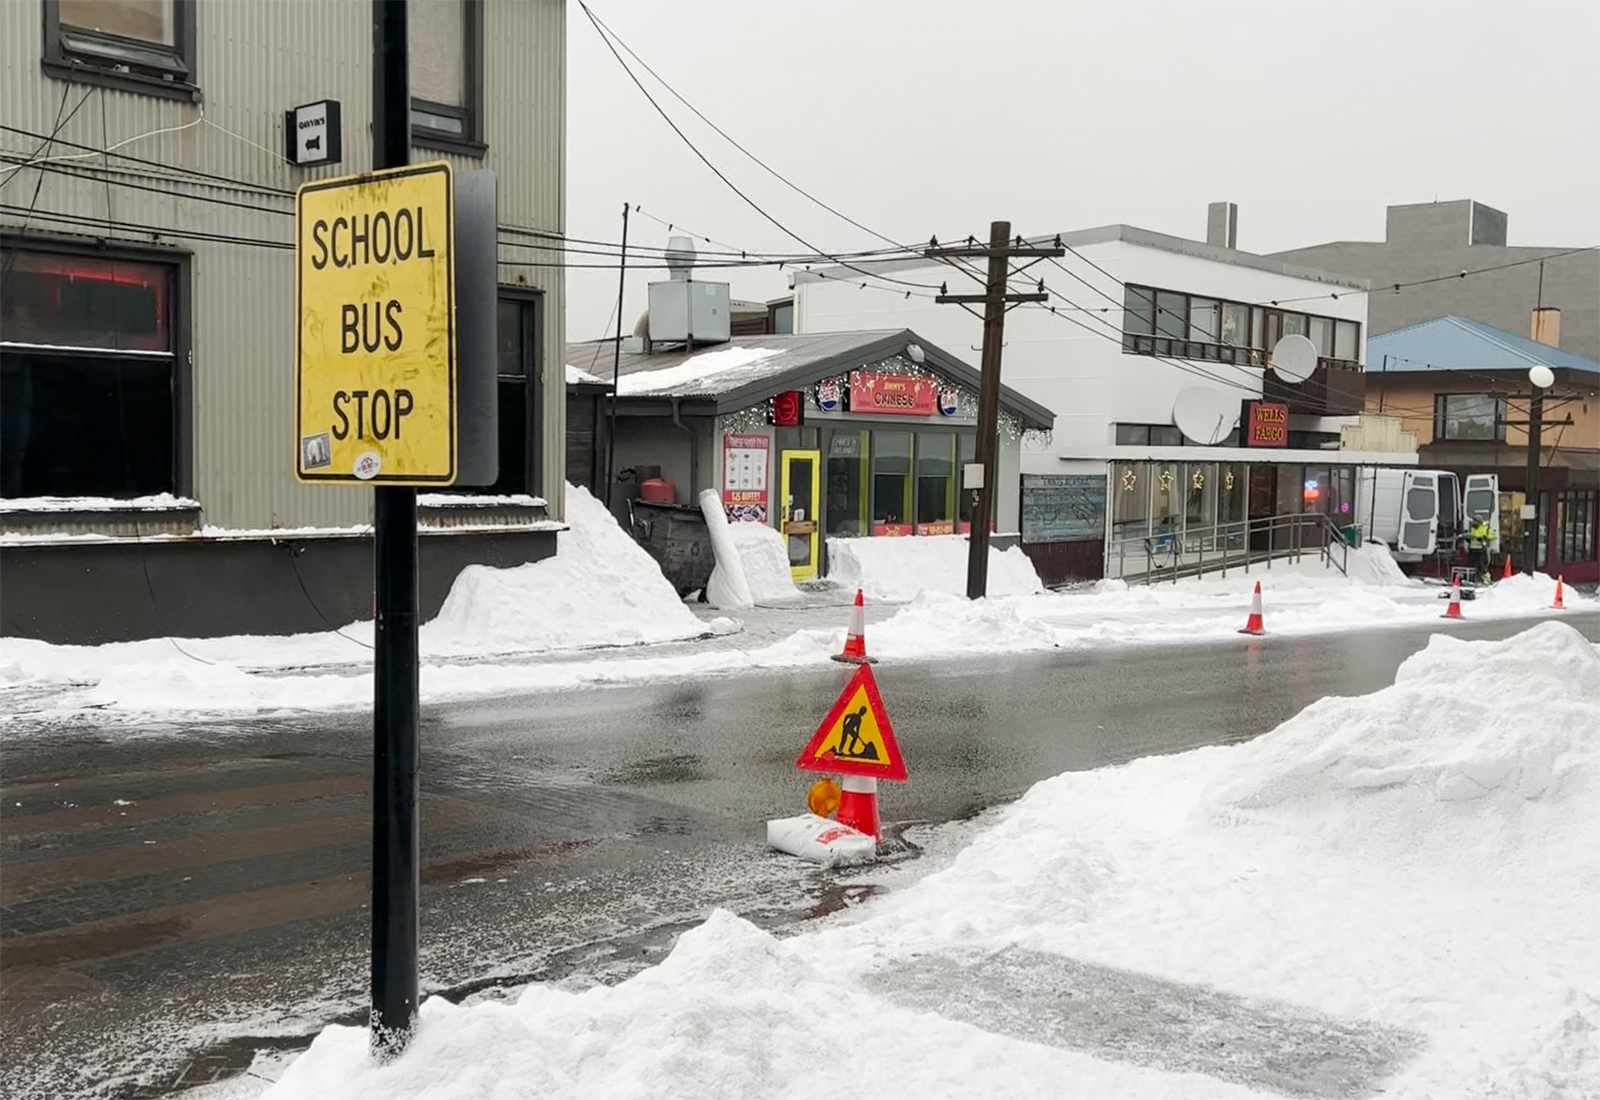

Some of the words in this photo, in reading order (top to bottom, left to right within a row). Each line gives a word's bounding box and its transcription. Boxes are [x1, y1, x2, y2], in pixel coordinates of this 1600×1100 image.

[311, 206, 435, 270] SCHOOL
[341, 299, 403, 354] BUS
[332, 388, 414, 441] STOP
[1254, 426, 1284, 441] FARGO
[1255, 408, 1285, 423] WELLS
